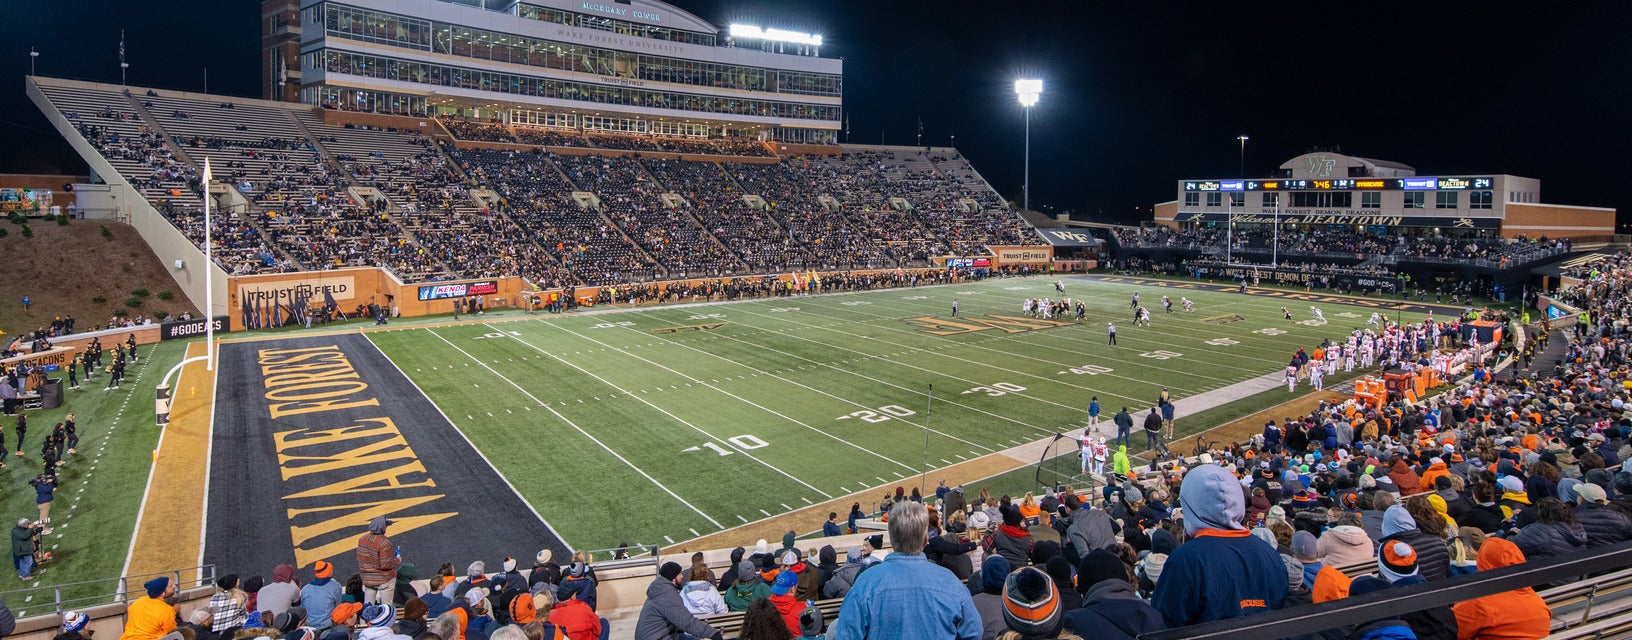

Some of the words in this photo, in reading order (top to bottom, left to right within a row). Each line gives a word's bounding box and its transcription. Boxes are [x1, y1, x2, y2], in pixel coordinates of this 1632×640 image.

[632, 10, 662, 21] TOWER
[557, 28, 586, 38] WAKE
[588, 34, 624, 46] FOREST
[628, 40, 684, 53] UNIVERSITY
[628, 79, 644, 87] FIELD
[1306, 156, 1336, 177] WF
[1186, 182, 1196, 190] 24
[1313, 181, 1330, 189] 7:46
[1398, 179, 1404, 188] 7
[1475, 179, 1489, 187] 24
[1231, 213, 1282, 223] Welcome
[1284, 216, 1299, 224] to
[1301, 214, 1403, 226] DEACTOWN
[1049, 230, 1089, 243] WF
[1246, 269, 1272, 280] FOEST
[1275, 271, 1299, 281] DEMON
[1358, 278, 1390, 288] #GODCS
[314, 284, 347, 295] FIELD
[438, 285, 466, 293] KENDA
[1069, 364, 1114, 375] 40
[257, 344, 382, 421] FOREST
[970, 382, 1028, 397] 30
[850, 404, 917, 424] 20
[702, 434, 770, 456] 10
[273, 416, 460, 569] WAKE
